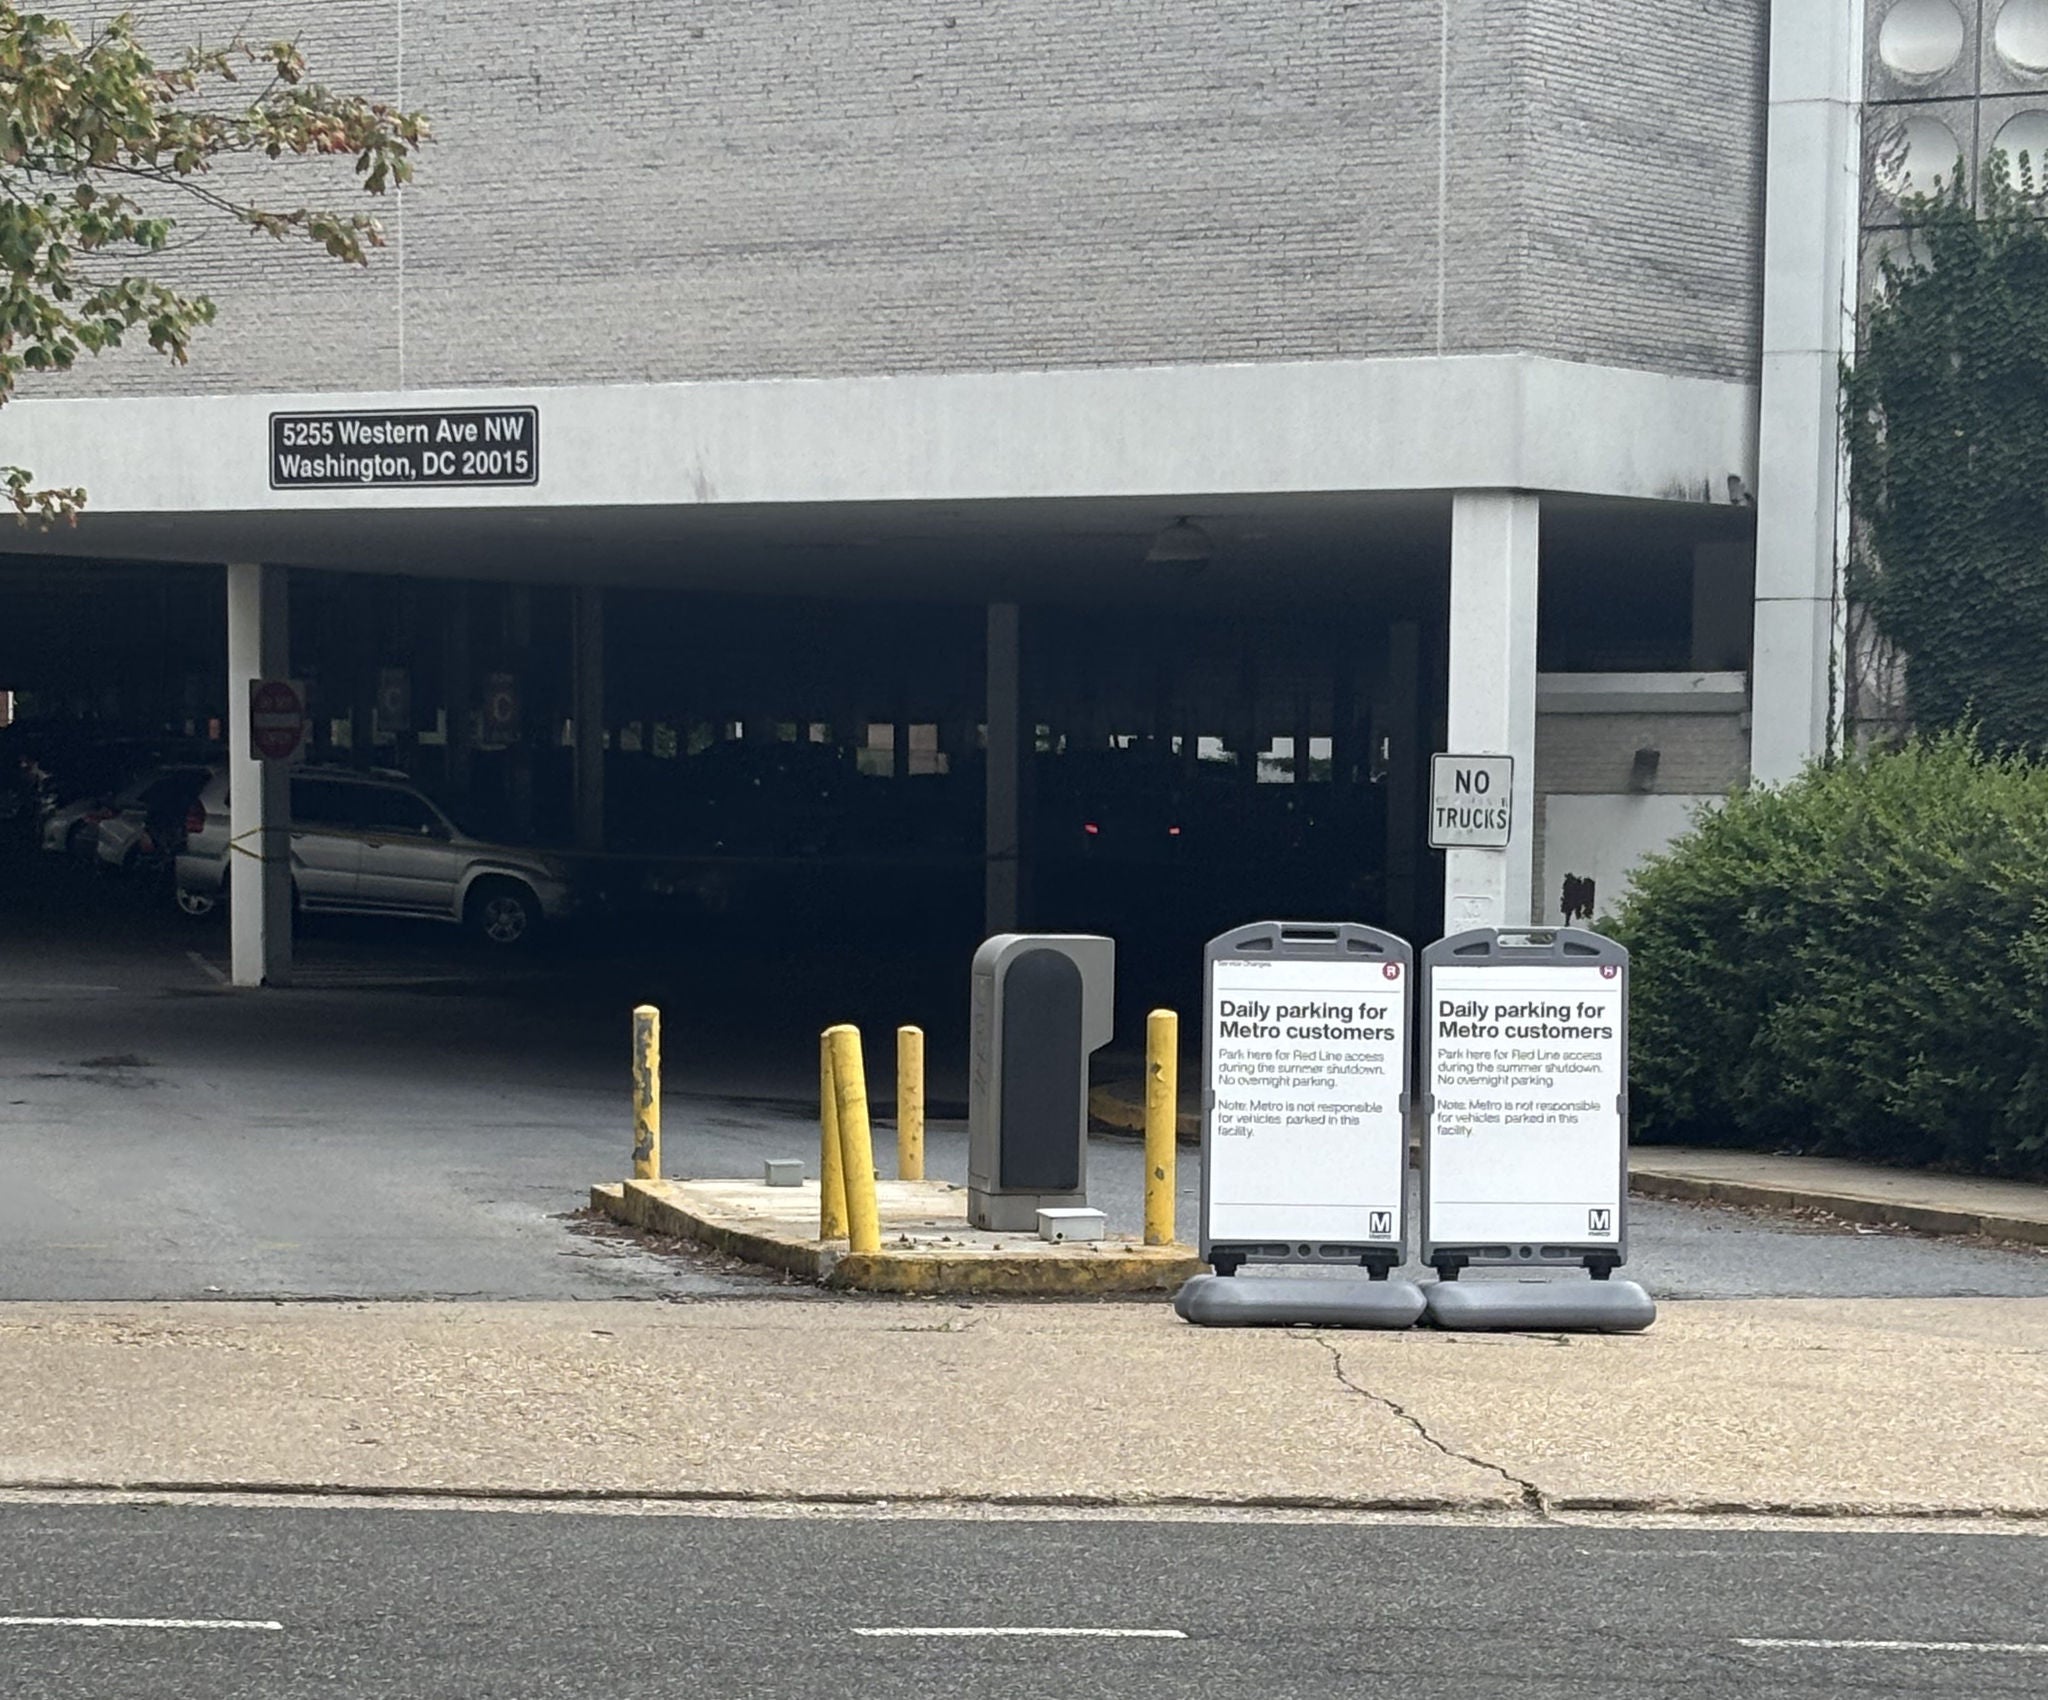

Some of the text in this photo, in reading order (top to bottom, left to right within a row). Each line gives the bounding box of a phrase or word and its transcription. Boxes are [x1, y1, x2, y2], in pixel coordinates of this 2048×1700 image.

[283, 416, 524, 446] 5255 Western Ave NW
[279, 450, 528, 482] Washington, DC 20015
[1455, 769, 1489, 794] NO
[1436, 807, 1507, 829] TRUCKS
[1220, 1001, 1387, 1023] Daily parking for
[1439, 1001, 1605, 1022] Daily parking for
[1220, 1021, 1395, 1040] Metro customers
[1439, 1021, 1613, 1039] Metro customers
[1219, 1049, 1384, 1062] Park here for Red Line access
[1438, 1049, 1602, 1060] Park here for Red Line access
[1219, 1063, 1255, 1075] during
[1257, 1063, 1275, 1073] the
[1278, 1066, 1323, 1074] summer
[1438, 1063, 1474, 1074] during
[1477, 1063, 1494, 1072] the
[1496, 1065, 1541, 1073] summer
[1219, 1075, 1338, 1089] No overnight parking.
[1438, 1075, 1454, 1085] No
[1457, 1075, 1508, 1088] overnight
[1250, 1101, 1283, 1112] Metro
[1286, 1102, 1295, 1112] is
[1297, 1103, 1315, 1112] not
[1318, 1103, 1382, 1114] responsible
[1469, 1100, 1502, 1111] Metro
[1505, 1101, 1513, 1111] is
[1516, 1102, 1533, 1111] not
[1536, 1101, 1600, 1113] responsible
[1218, 1114, 1360, 1126] for vehicles parked in this
[1438, 1113, 1578, 1125] for vehicles parked in this
[1370, 1212, 1391, 1233] M
[1589, 1209, 1610, 1230] M
